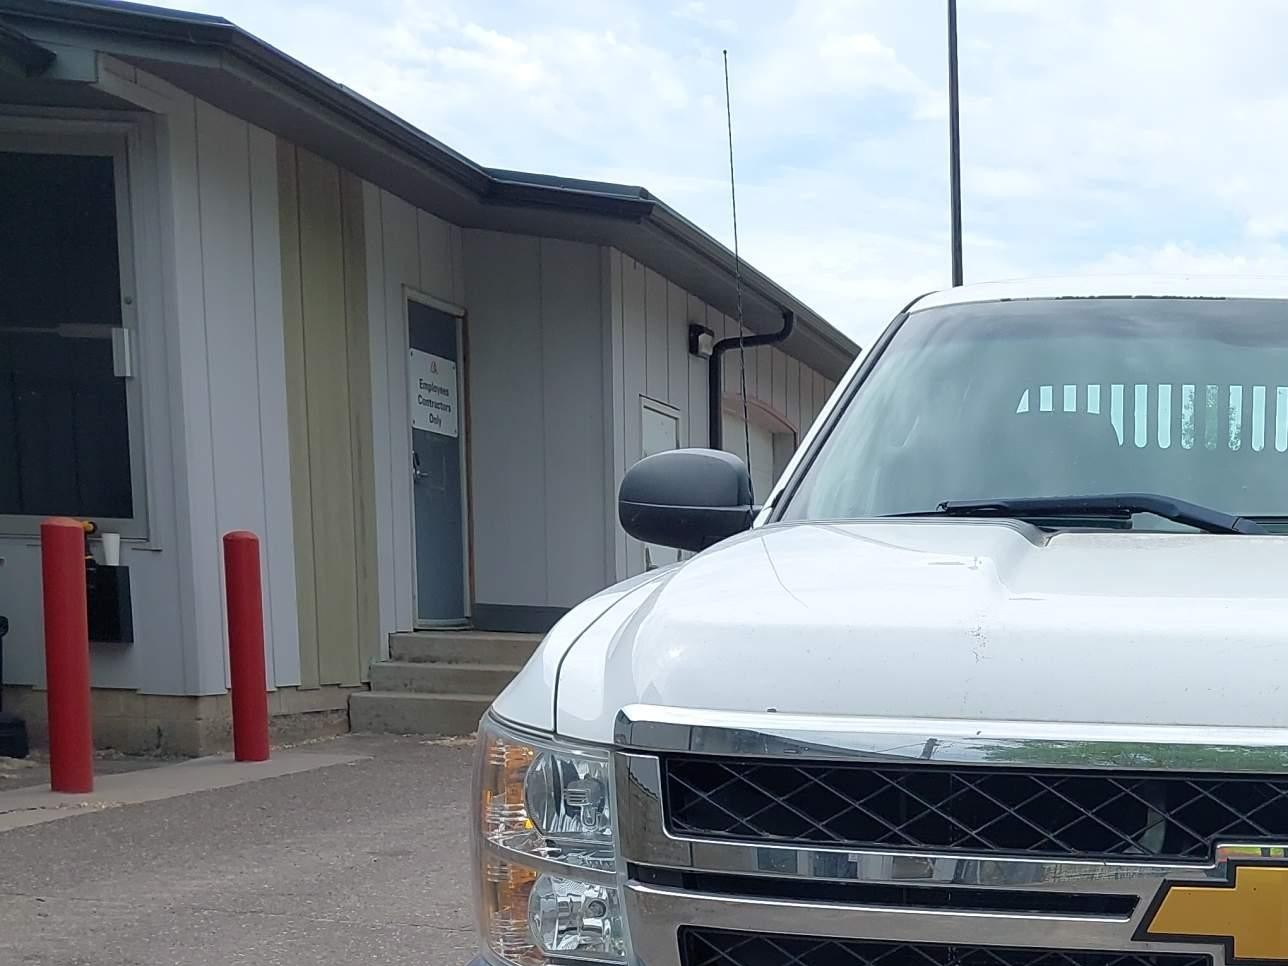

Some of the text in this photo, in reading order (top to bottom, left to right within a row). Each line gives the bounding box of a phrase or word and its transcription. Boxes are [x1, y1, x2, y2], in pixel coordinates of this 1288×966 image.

[419, 378, 449, 397] Employees
[418, 394, 451, 413] Contractors
[429, 413, 442, 428] Only
